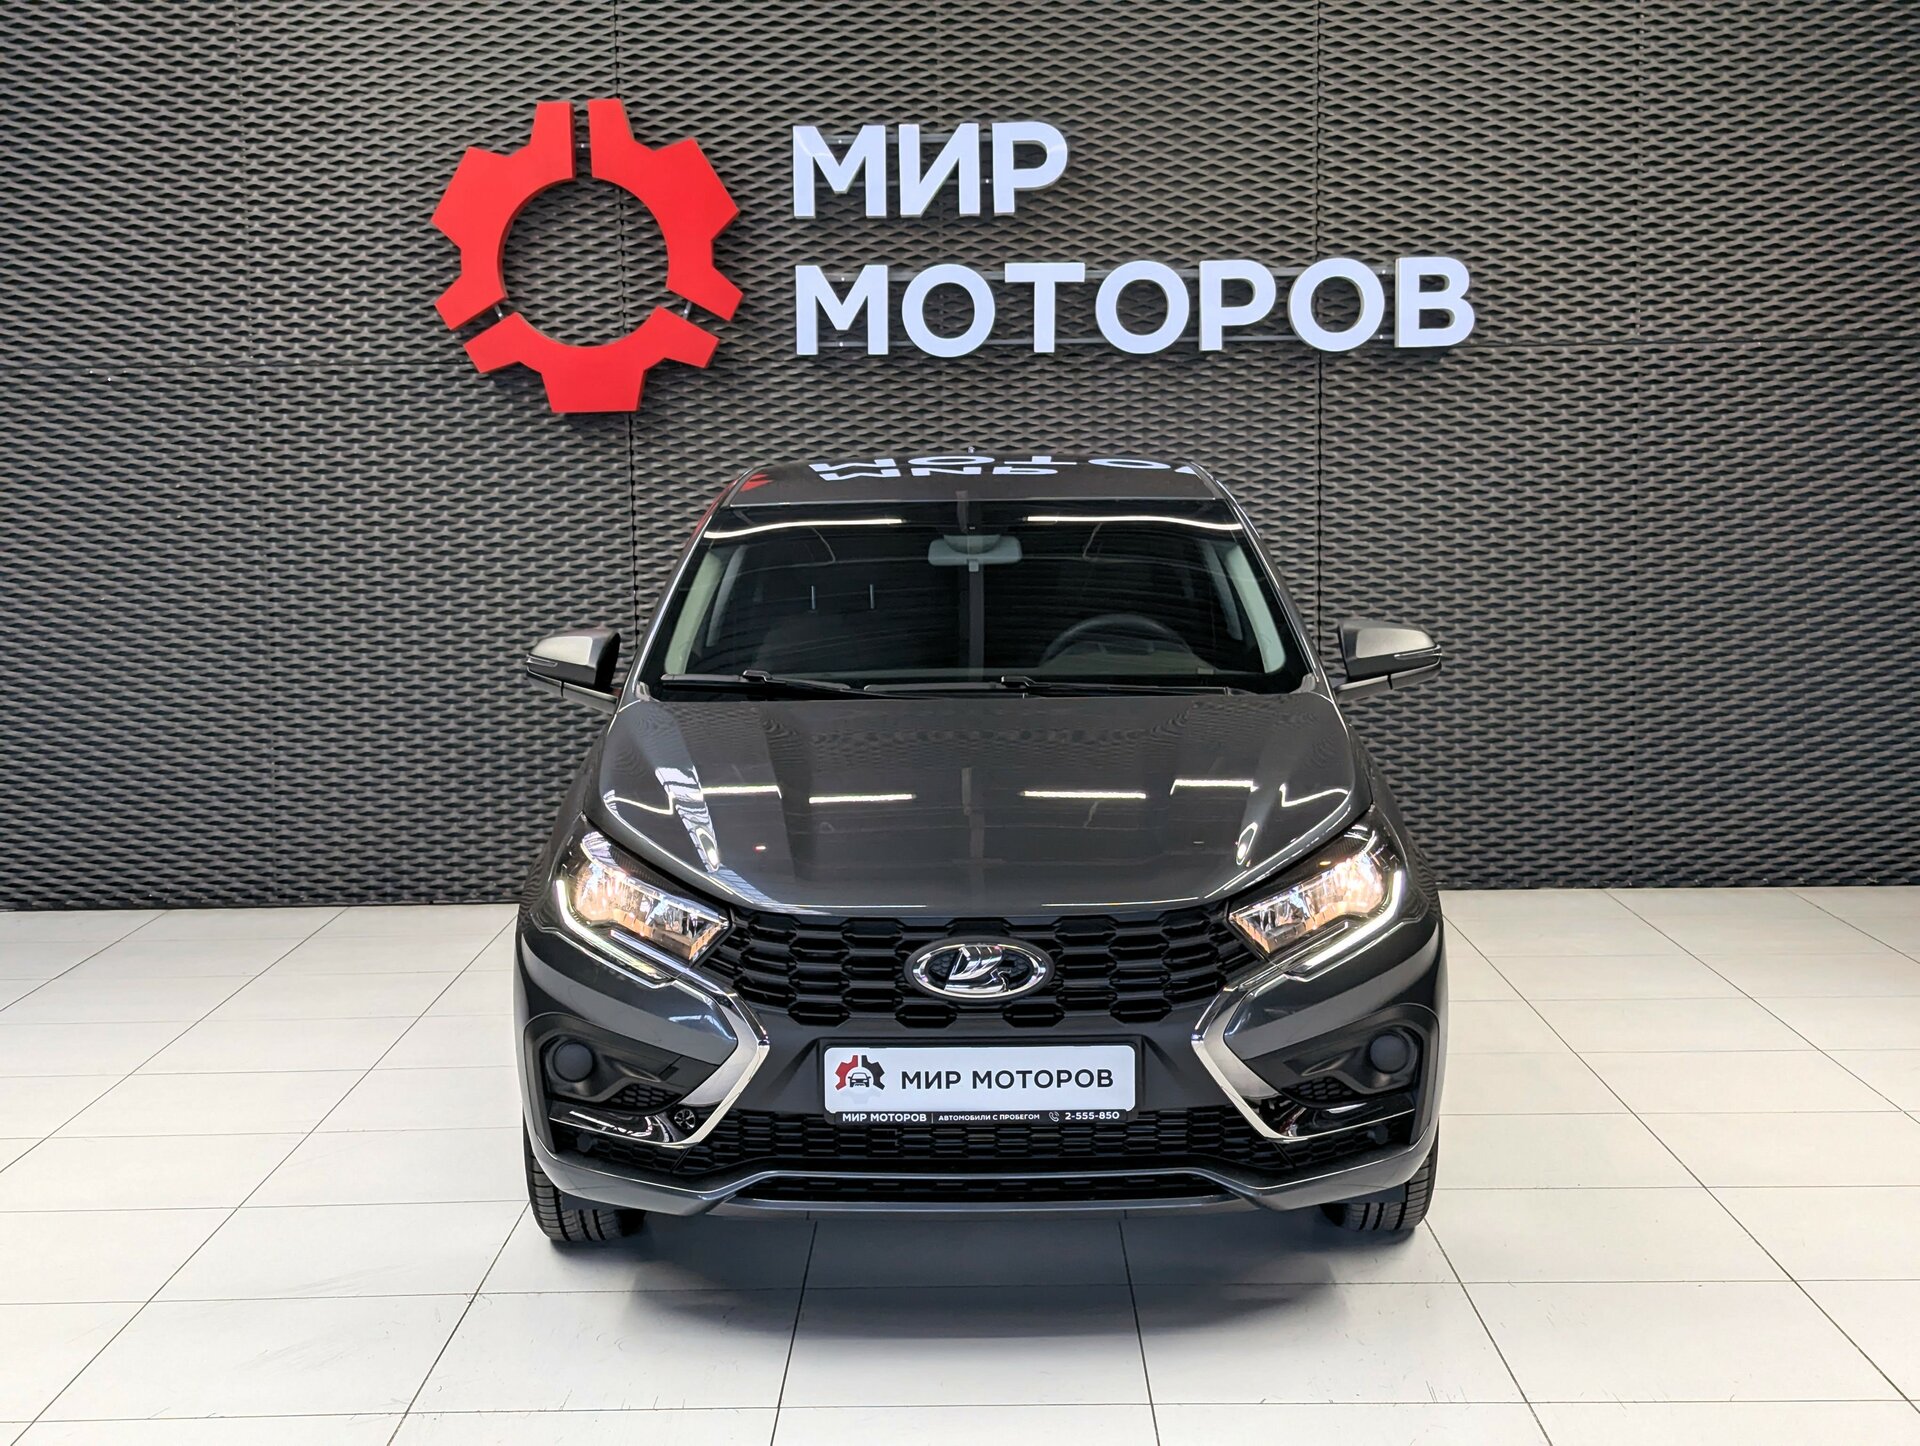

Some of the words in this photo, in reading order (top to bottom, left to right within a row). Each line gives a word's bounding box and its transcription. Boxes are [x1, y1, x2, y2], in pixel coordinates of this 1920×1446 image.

[792, 121, 1068, 217] МИР
[795, 256, 1475, 357] МОТОРОВ
[901, 1070, 962, 1090] МИР
[972, 1068, 1114, 1089] МОТОРОВ
[842, 1112, 868, 1122] МИР
[870, 1112, 928, 1122] МОТОРОВ
[999, 1113, 1040, 1121] ПРОБЕГОМ
[1064, 1111, 1120, 1120] 2-555-850
